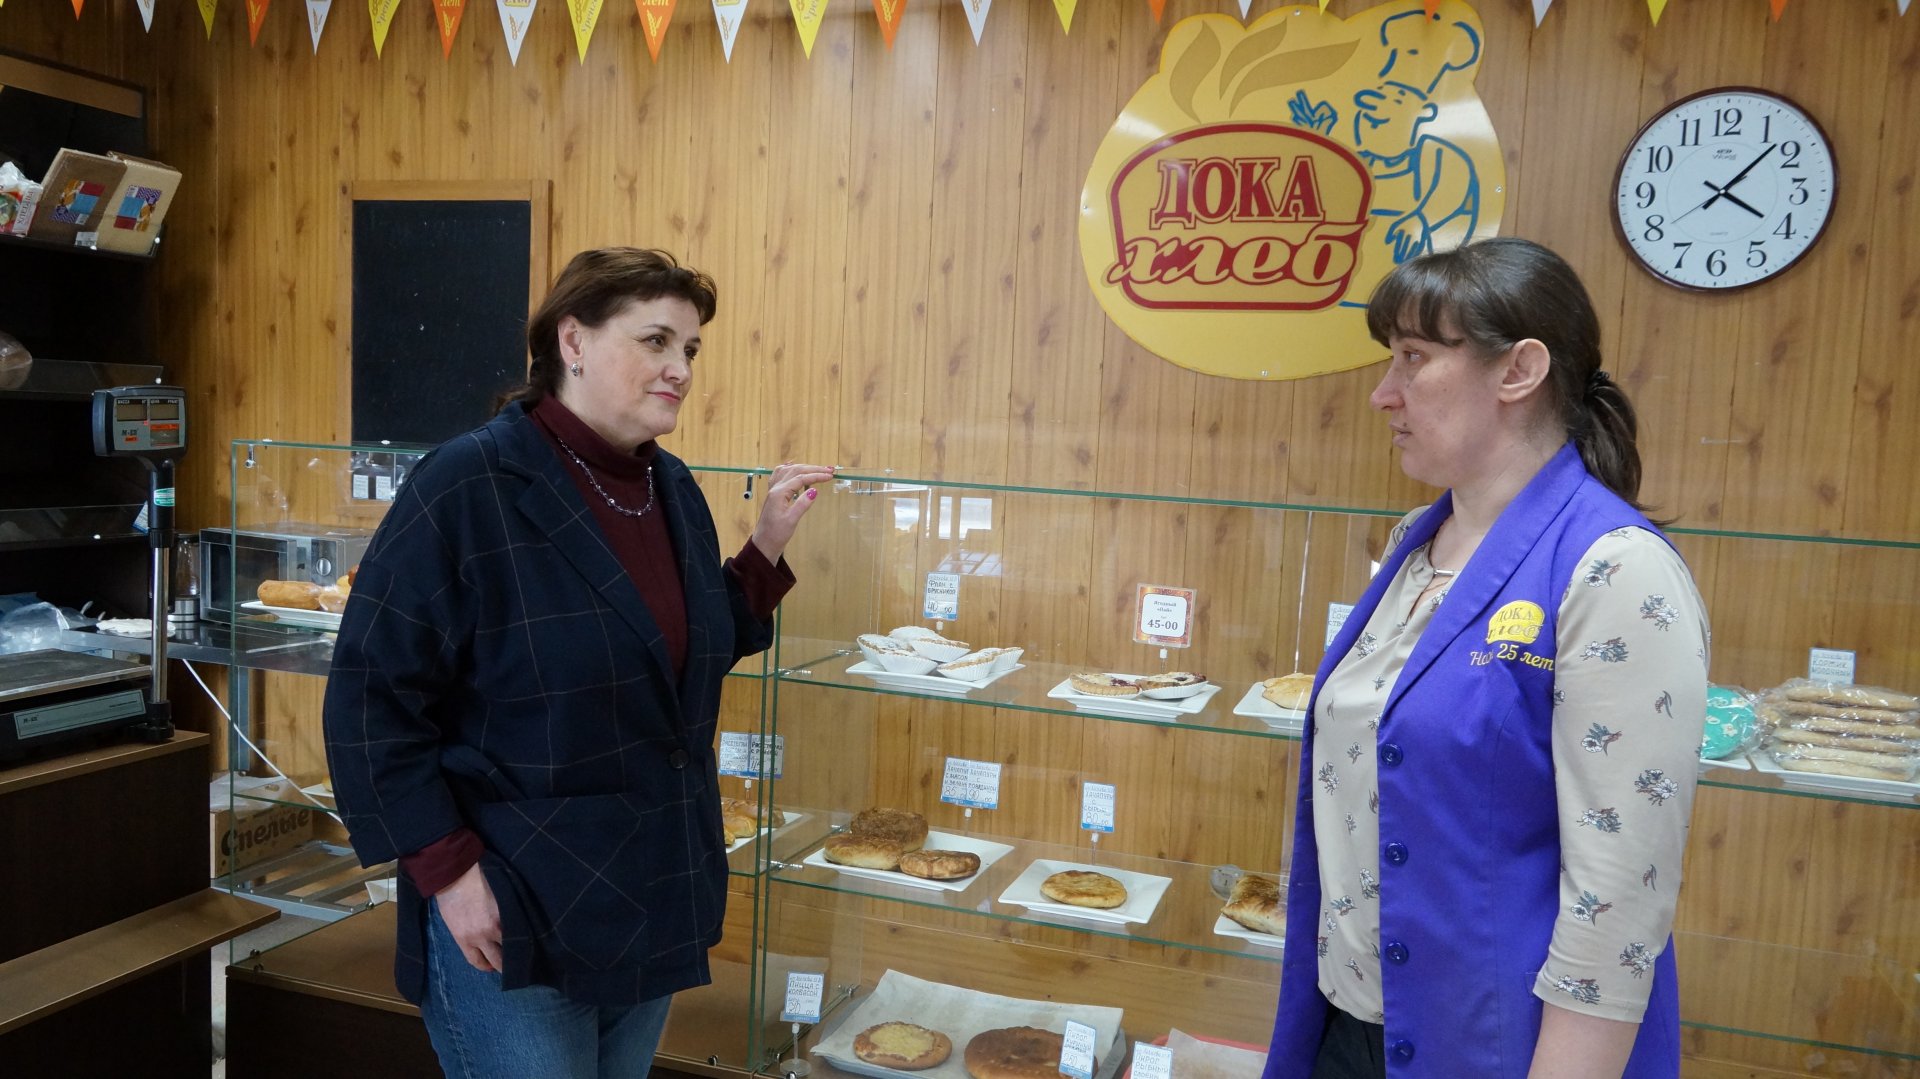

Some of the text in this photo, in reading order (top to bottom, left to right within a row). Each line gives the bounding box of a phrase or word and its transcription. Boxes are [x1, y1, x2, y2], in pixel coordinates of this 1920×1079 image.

[1680, 118, 1702, 146] 11
[1712, 108, 1742, 137] 12
[1760, 115, 1771, 143] 1
[1645, 145, 1673, 173] 10
[1780, 140, 1801, 169] 2
[1150, 156, 1325, 230] ДОКА
[1635, 181, 1656, 209] 9
[1788, 177, 1809, 205] 3
[1644, 214, 1664, 241] 8
[1772, 212, 1796, 239] 4
[1106, 220, 1369, 287] хлеб
[1673, 241, 1693, 268] 7
[1706, 249, 1727, 277] 6
[1746, 240, 1767, 267] 5
[1147, 619, 1179, 631] 45-00
[1496, 643, 1519, 660] 25
[1520, 651, 1554, 671] лет
[221, 809, 310, 857] Спелые
